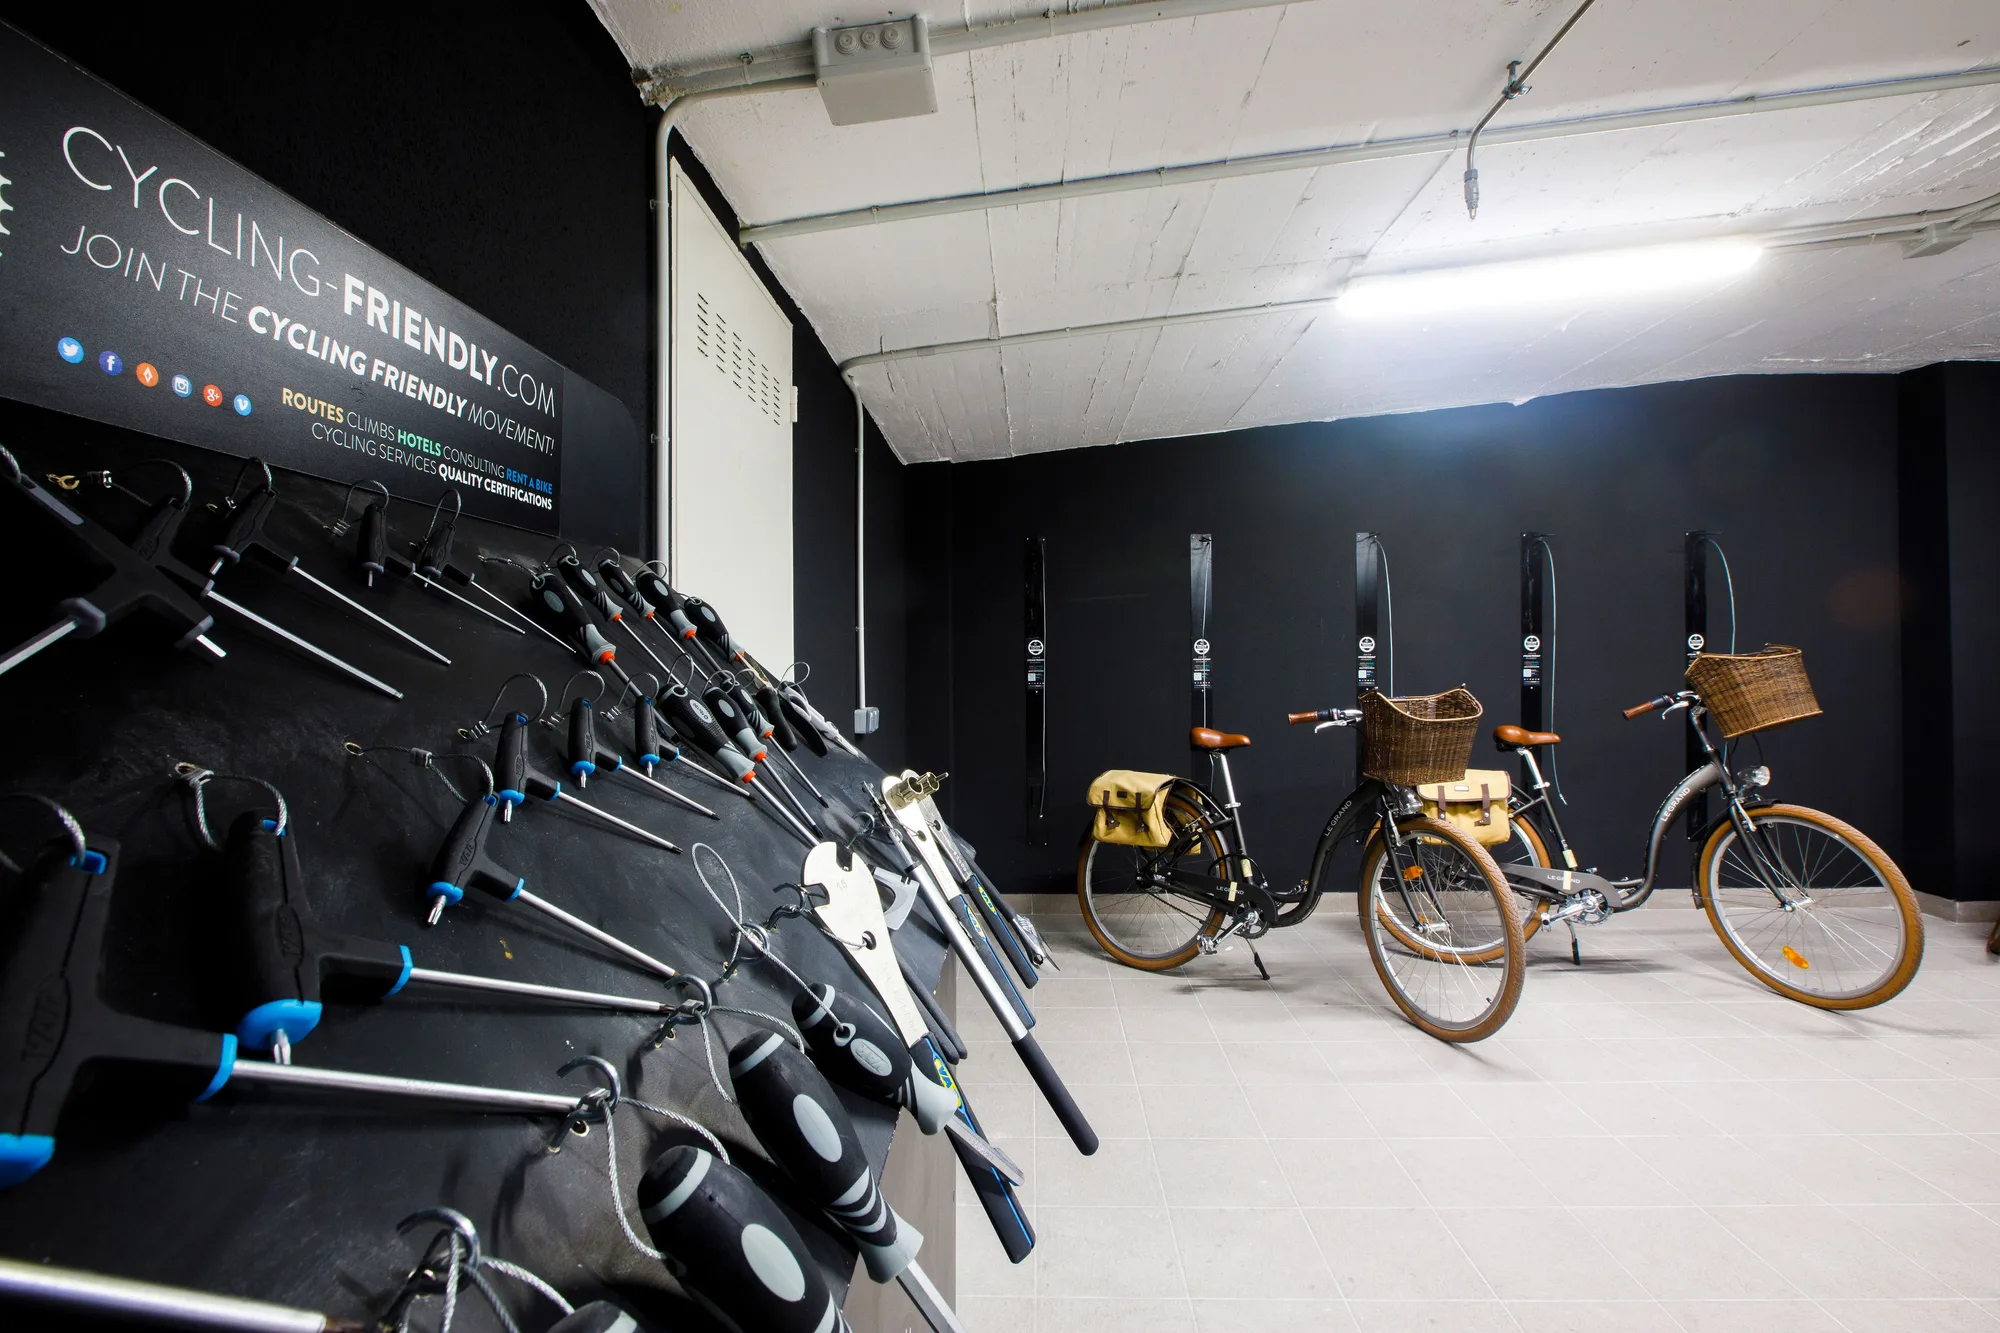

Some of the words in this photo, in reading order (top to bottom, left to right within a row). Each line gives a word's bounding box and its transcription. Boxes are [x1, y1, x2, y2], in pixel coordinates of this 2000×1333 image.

[60, 225, 166, 291] JOIN
[178, 269, 243, 323] THE
[248, 305, 366, 375] CYCLING
[371, 359, 468, 418] FRIENDLY
[468, 402, 555, 456] MOVEMENT!
[62, 126, 556, 418] CYCLING-FRIENDLY.COM
[282, 387, 344, 423] ROUTES
[347, 412, 395, 441] CLIMBS
[397, 429, 442, 457] HOTELS
[443, 445, 505, 478] CONSULTING
[506, 468, 528, 487] RENT
[529, 478, 535, 488] A
[535, 479, 552, 495] BIKE
[311, 422, 377, 456] CYCLING
[379, 447, 437, 475] SERVICES
[438, 463, 483, 489] QUALITY
[484, 478, 552, 510] CERTIFICATIONS
